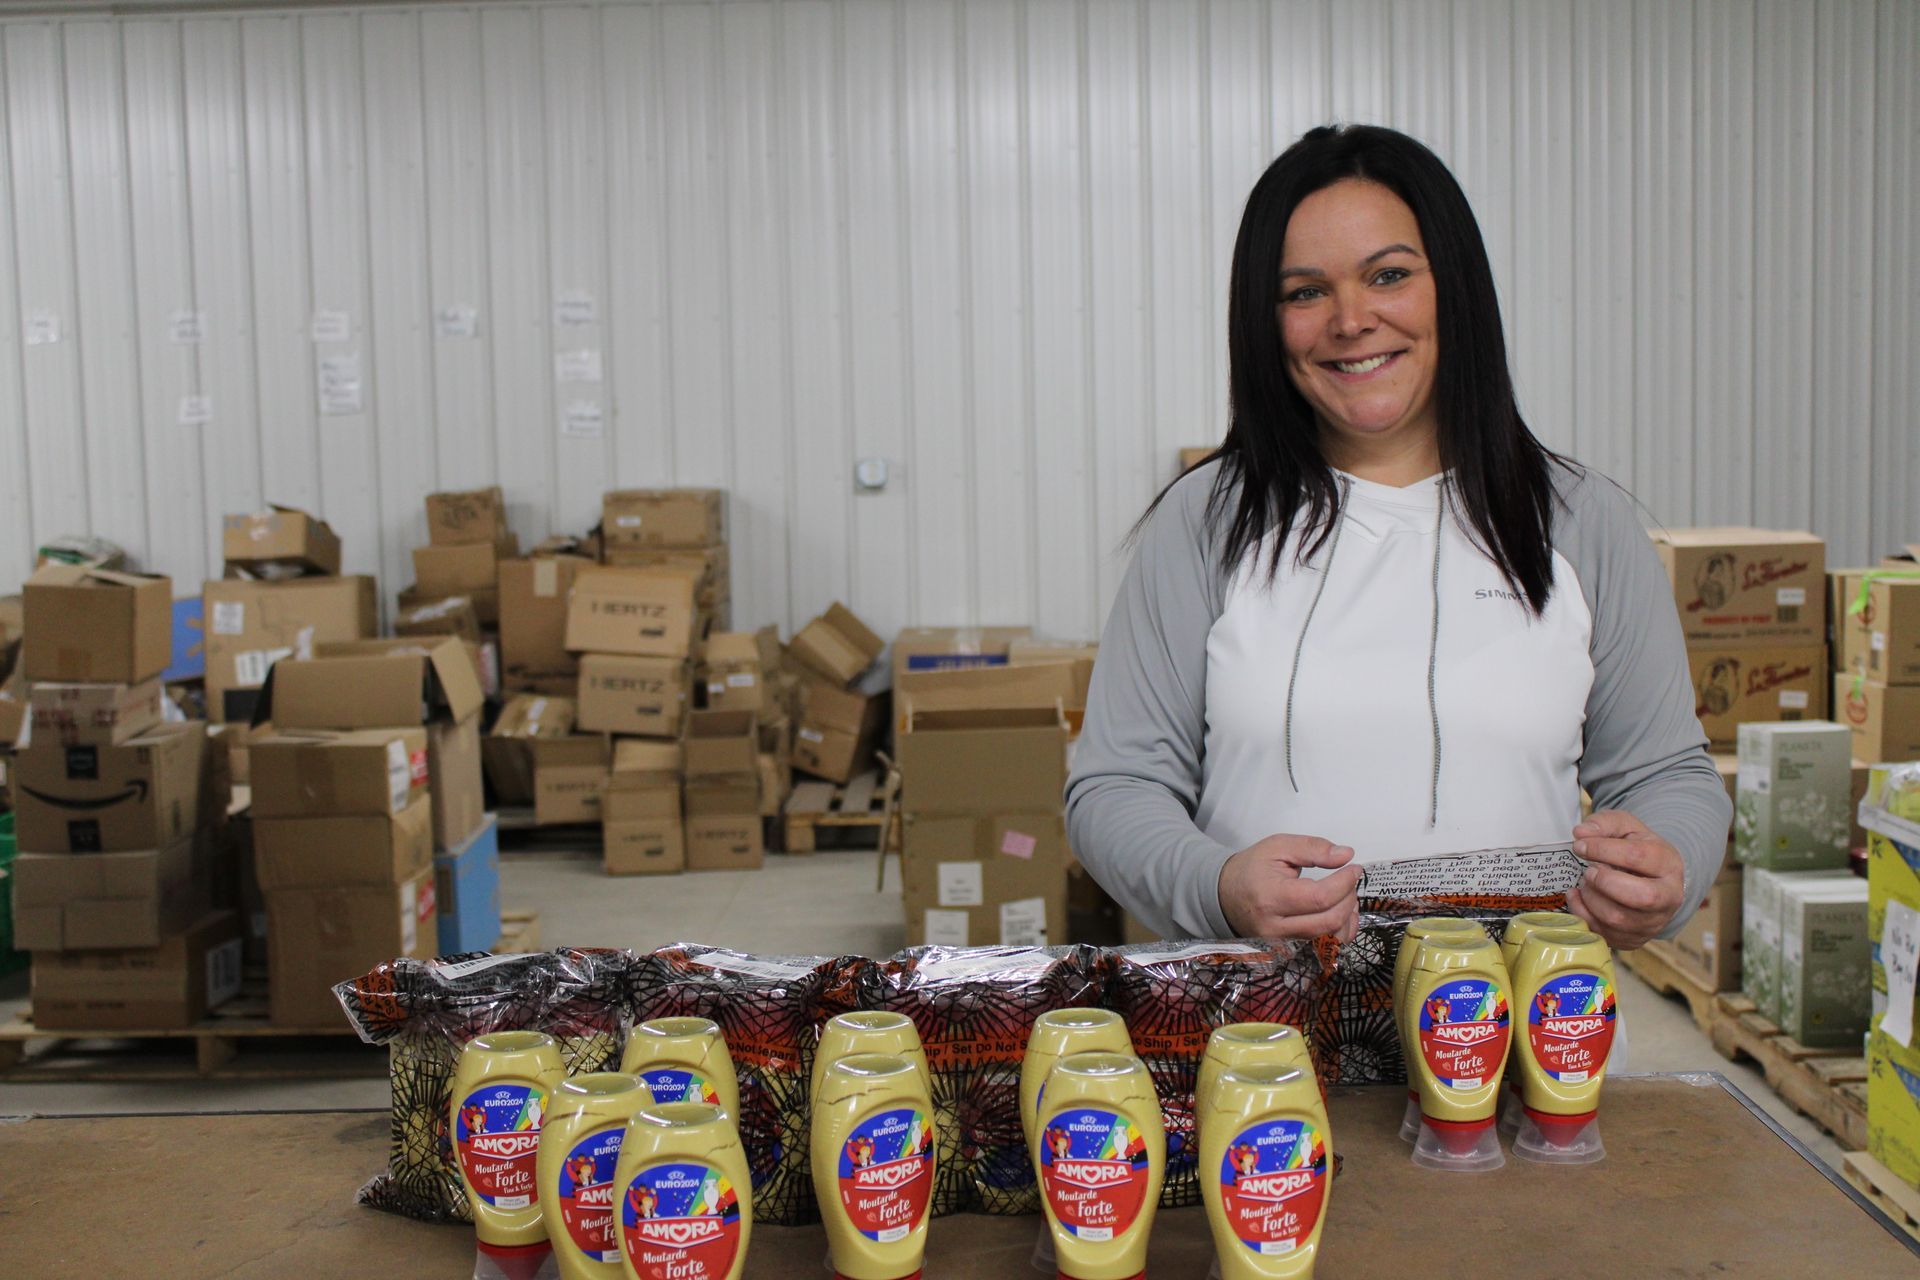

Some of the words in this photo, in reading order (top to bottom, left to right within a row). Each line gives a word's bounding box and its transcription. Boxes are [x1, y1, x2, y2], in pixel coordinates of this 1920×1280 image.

[592, 601, 667, 618] HERTZ
[590, 676, 665, 693] HERTZ
[1436, 1024, 1496, 1042] AMORA
[1545, 1018, 1603, 1036] AMORA
[736, 1042, 755, 1054] Not
[952, 1043, 972, 1054] Set
[976, 1043, 992, 1053] Do
[995, 1041, 1016, 1052] Not
[1144, 1037, 1173, 1050] Ship
[1543, 1041, 1579, 1053] Moutarde
[1435, 1047, 1471, 1060] Moutarde
[1561, 1048, 1591, 1064] Forte
[1454, 1056, 1485, 1072] Forte
[473, 1135, 540, 1155] AMORA
[594, 1144, 621, 1156] EURO2
[475, 1161, 514, 1174] Moutarde
[859, 1159, 922, 1184] AMORA
[1057, 1163, 1128, 1184] AMORA
[495, 1170, 531, 1188] Forte
[1241, 1173, 1311, 1197] AMORA
[859, 1191, 898, 1211] Moutarde
[1057, 1190, 1097, 1201] Moutarde
[880, 1199, 911, 1221] Forte
[1078, 1200, 1114, 1217] Forte
[1240, 1202, 1284, 1220] Moutarde
[581, 1215, 613, 1231] Moutar
[1263, 1212, 1298, 1233] Forte
[642, 1221, 719, 1243] AMORA
[643, 1249, 688, 1264] Moutarde
[666, 1259, 705, 1279] Forte
